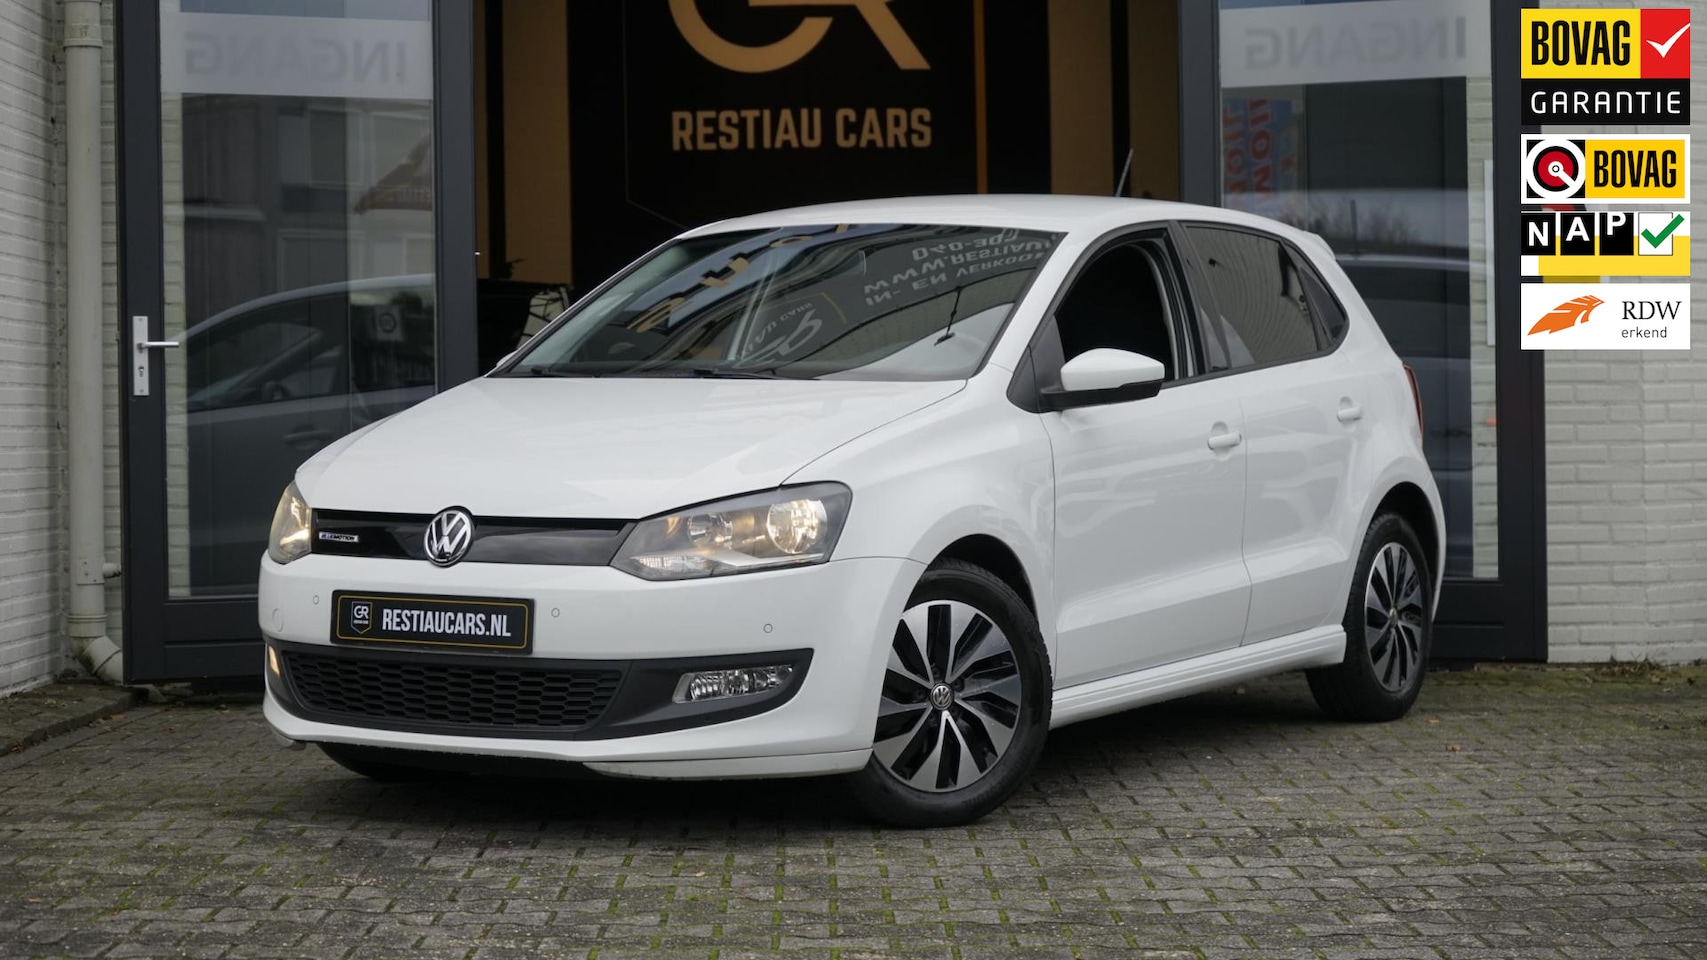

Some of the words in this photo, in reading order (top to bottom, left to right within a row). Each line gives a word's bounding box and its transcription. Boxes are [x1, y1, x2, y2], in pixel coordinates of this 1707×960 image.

[671, 108, 822, 151] RESTIAU
[835, 107, 932, 148] CARS
[382, 608, 512, 637] RESTIAUCARS.NL
